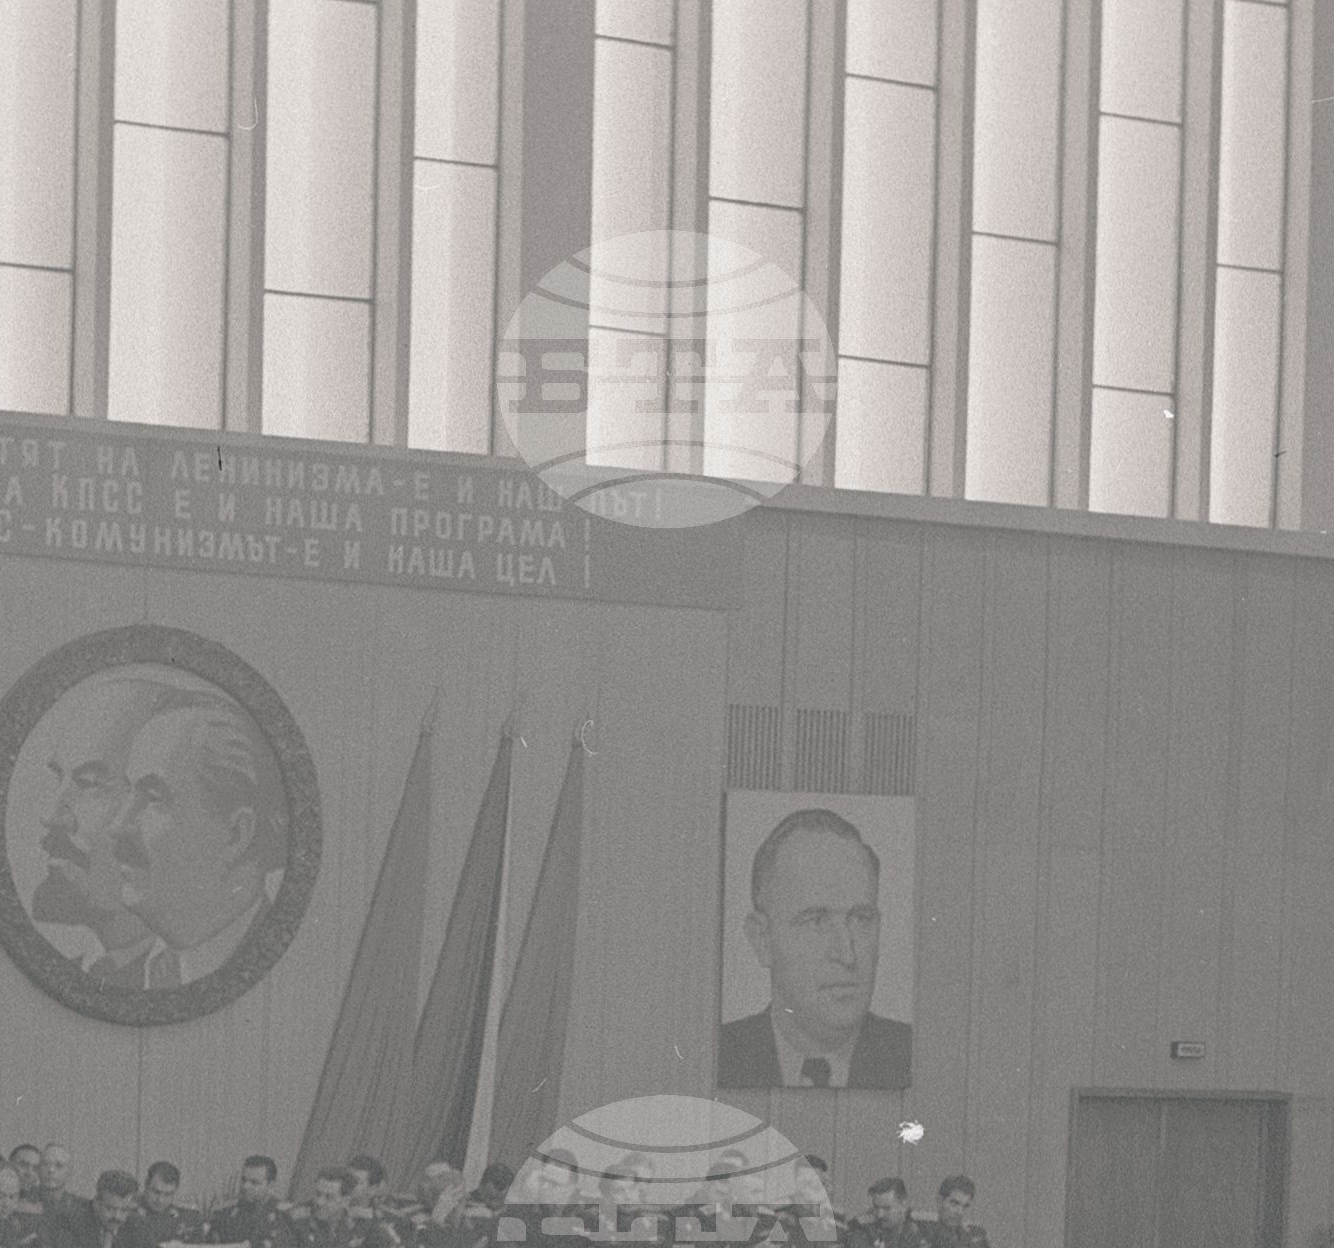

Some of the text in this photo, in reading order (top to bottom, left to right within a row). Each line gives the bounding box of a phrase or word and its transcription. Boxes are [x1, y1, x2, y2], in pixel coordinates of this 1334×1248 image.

[52, 474, 143, 515] КПСС
[174, 489, 191, 519] Е
[218, 493, 235, 522] И
[265, 497, 363, 533] НАША
[97, 446, 139, 478] НА
[457, 476, 474, 504] И
[343, 541, 361, 570] И
[388, 545, 477, 580] НАША
